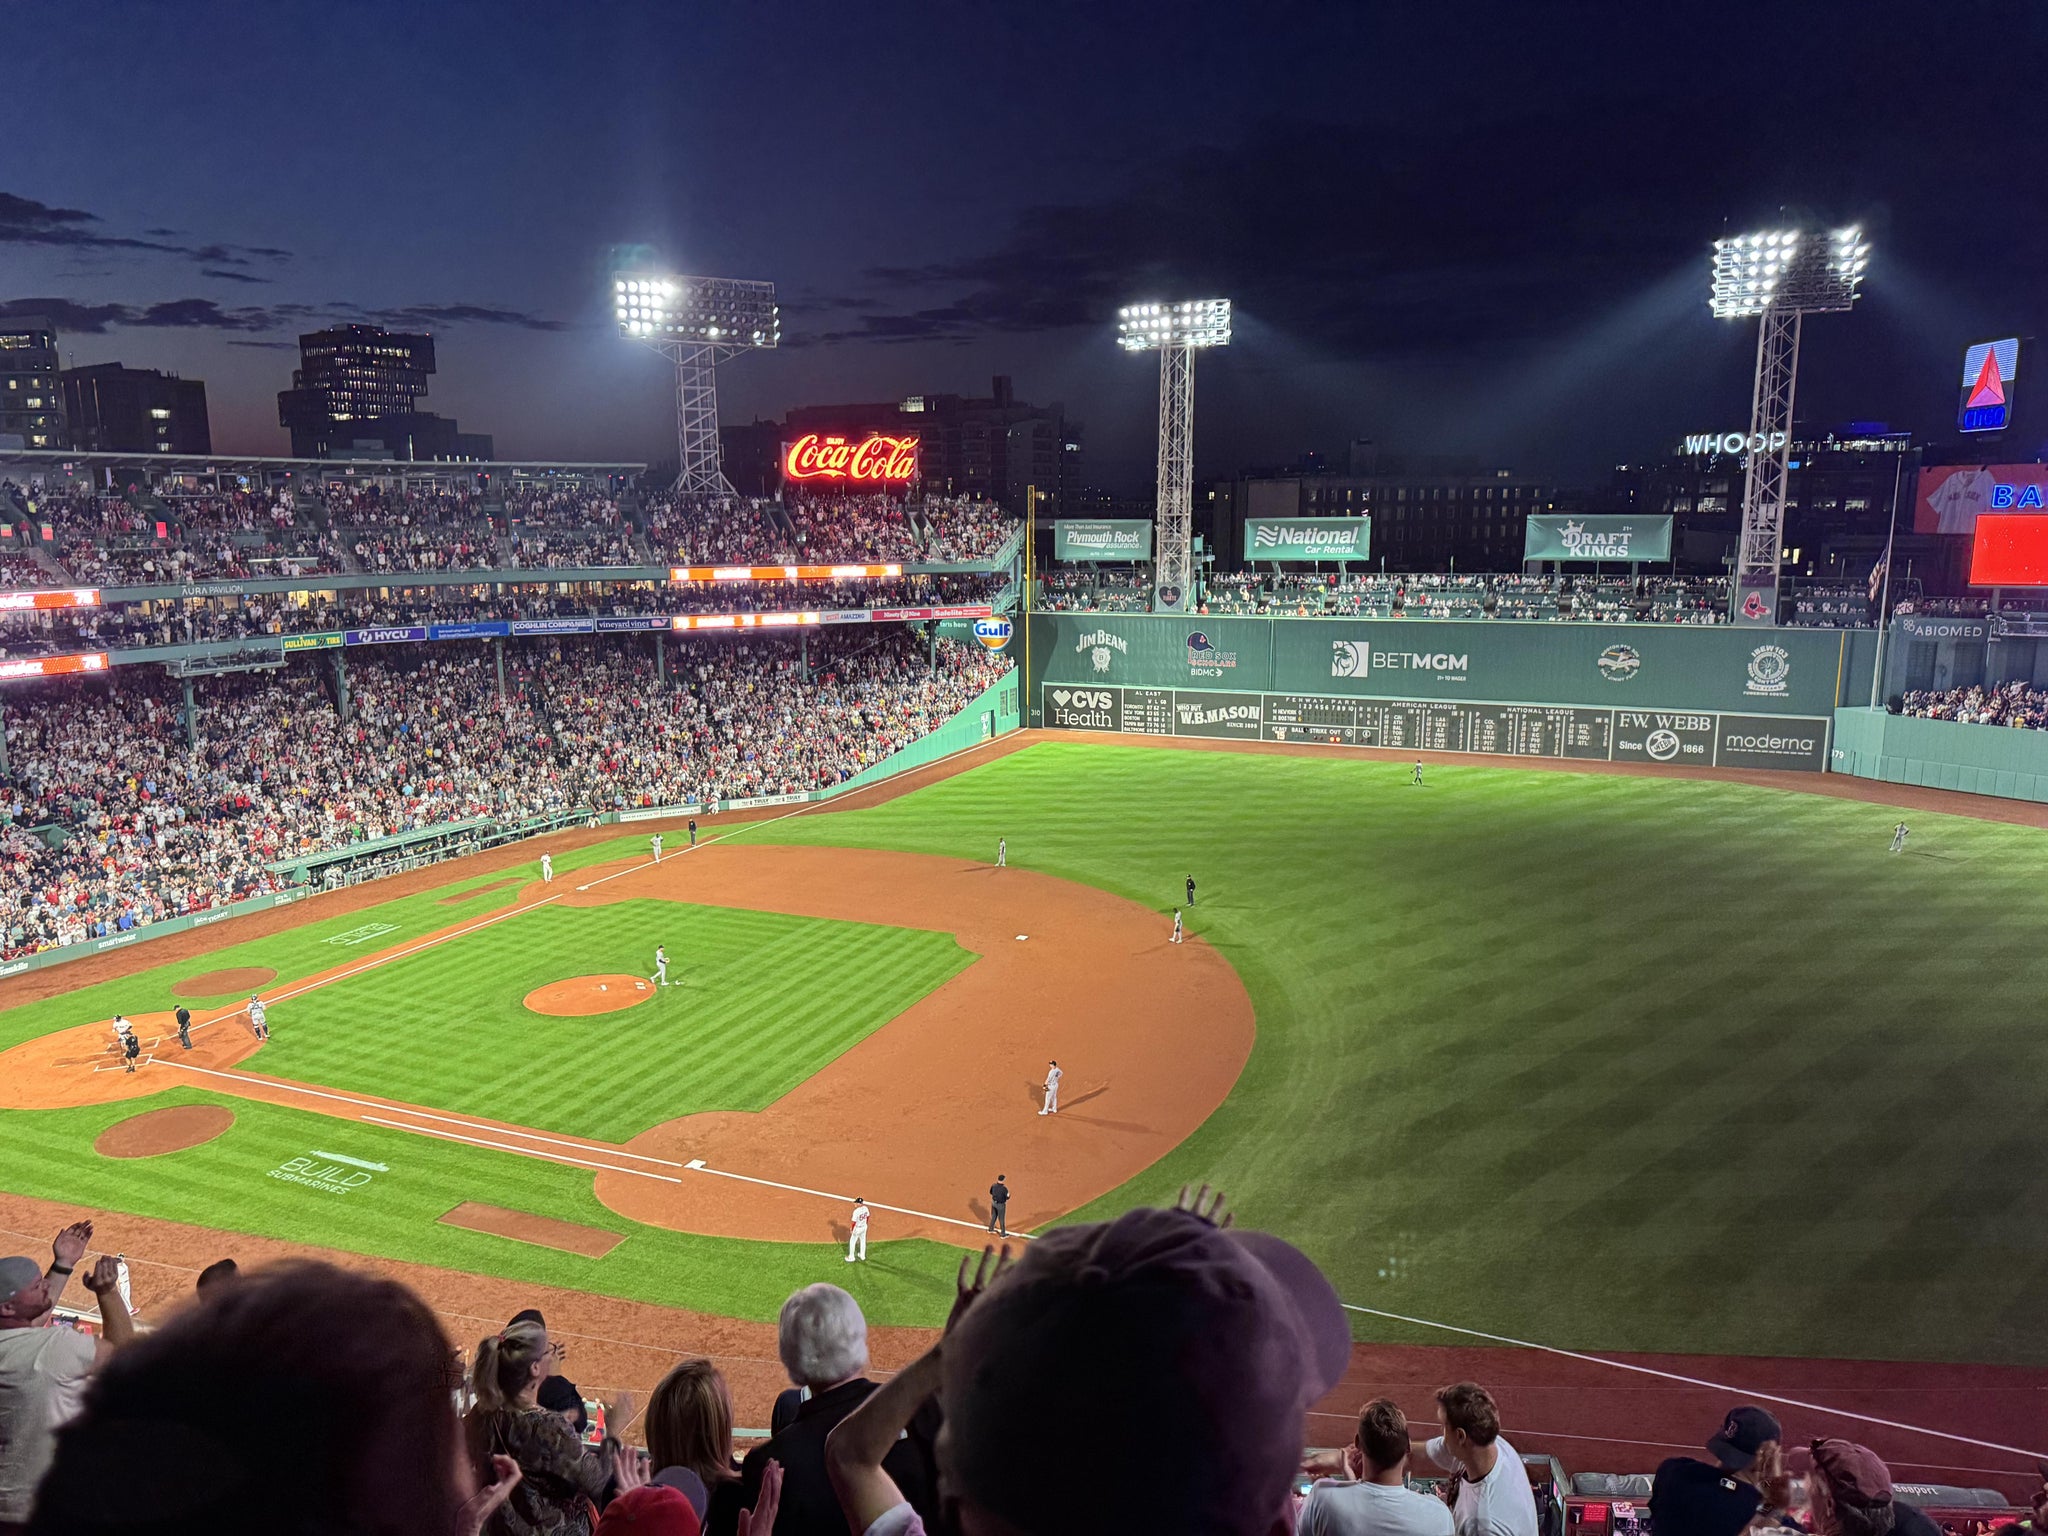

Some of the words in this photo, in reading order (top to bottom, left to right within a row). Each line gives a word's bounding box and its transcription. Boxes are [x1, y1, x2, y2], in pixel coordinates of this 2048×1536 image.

[1686, 432, 1786, 455] WHOOP
[1067, 531, 1112, 543] Plymouth
[1115, 531, 1139, 543] Rock
[1278, 527, 1359, 544] National
[1562, 532, 1632, 548] DRAFT
[1324, 545, 1354, 553] Rental
[1570, 546, 1628, 557] KINGS
[209, 585, 243, 594] PAVILION
[375, 630, 408, 640] HYCU
[975, 623, 1011, 636] Gulf
[1914, 626, 1982, 637] ABIOMED
[285, 637, 316, 648] SULLIVAN
[1076, 634, 1096, 653] JIM
[1097, 630, 1128, 655] BEAM
[1192, 651, 1212, 660] RED
[1215, 652, 1237, 660] SOX
[1751, 645, 1774, 658] IBEW
[1775, 647, 1789, 659] 103
[1373, 652, 1468, 670] BETMGM
[1191, 668, 1214, 676] BIDMC
[1072, 690, 1112, 710] CVS
[1055, 708, 1112, 727] Health
[1655, 715, 1711, 731] WEBB
[1619, 740, 1643, 751] Since
[1682, 745, 1704, 754] 1866
[1726, 734, 1813, 750] moderna
[98, 932, 136, 949] smartwater
[280, 1157, 372, 1187] BUILD
[266, 1170, 350, 1195] SUBMARINES
